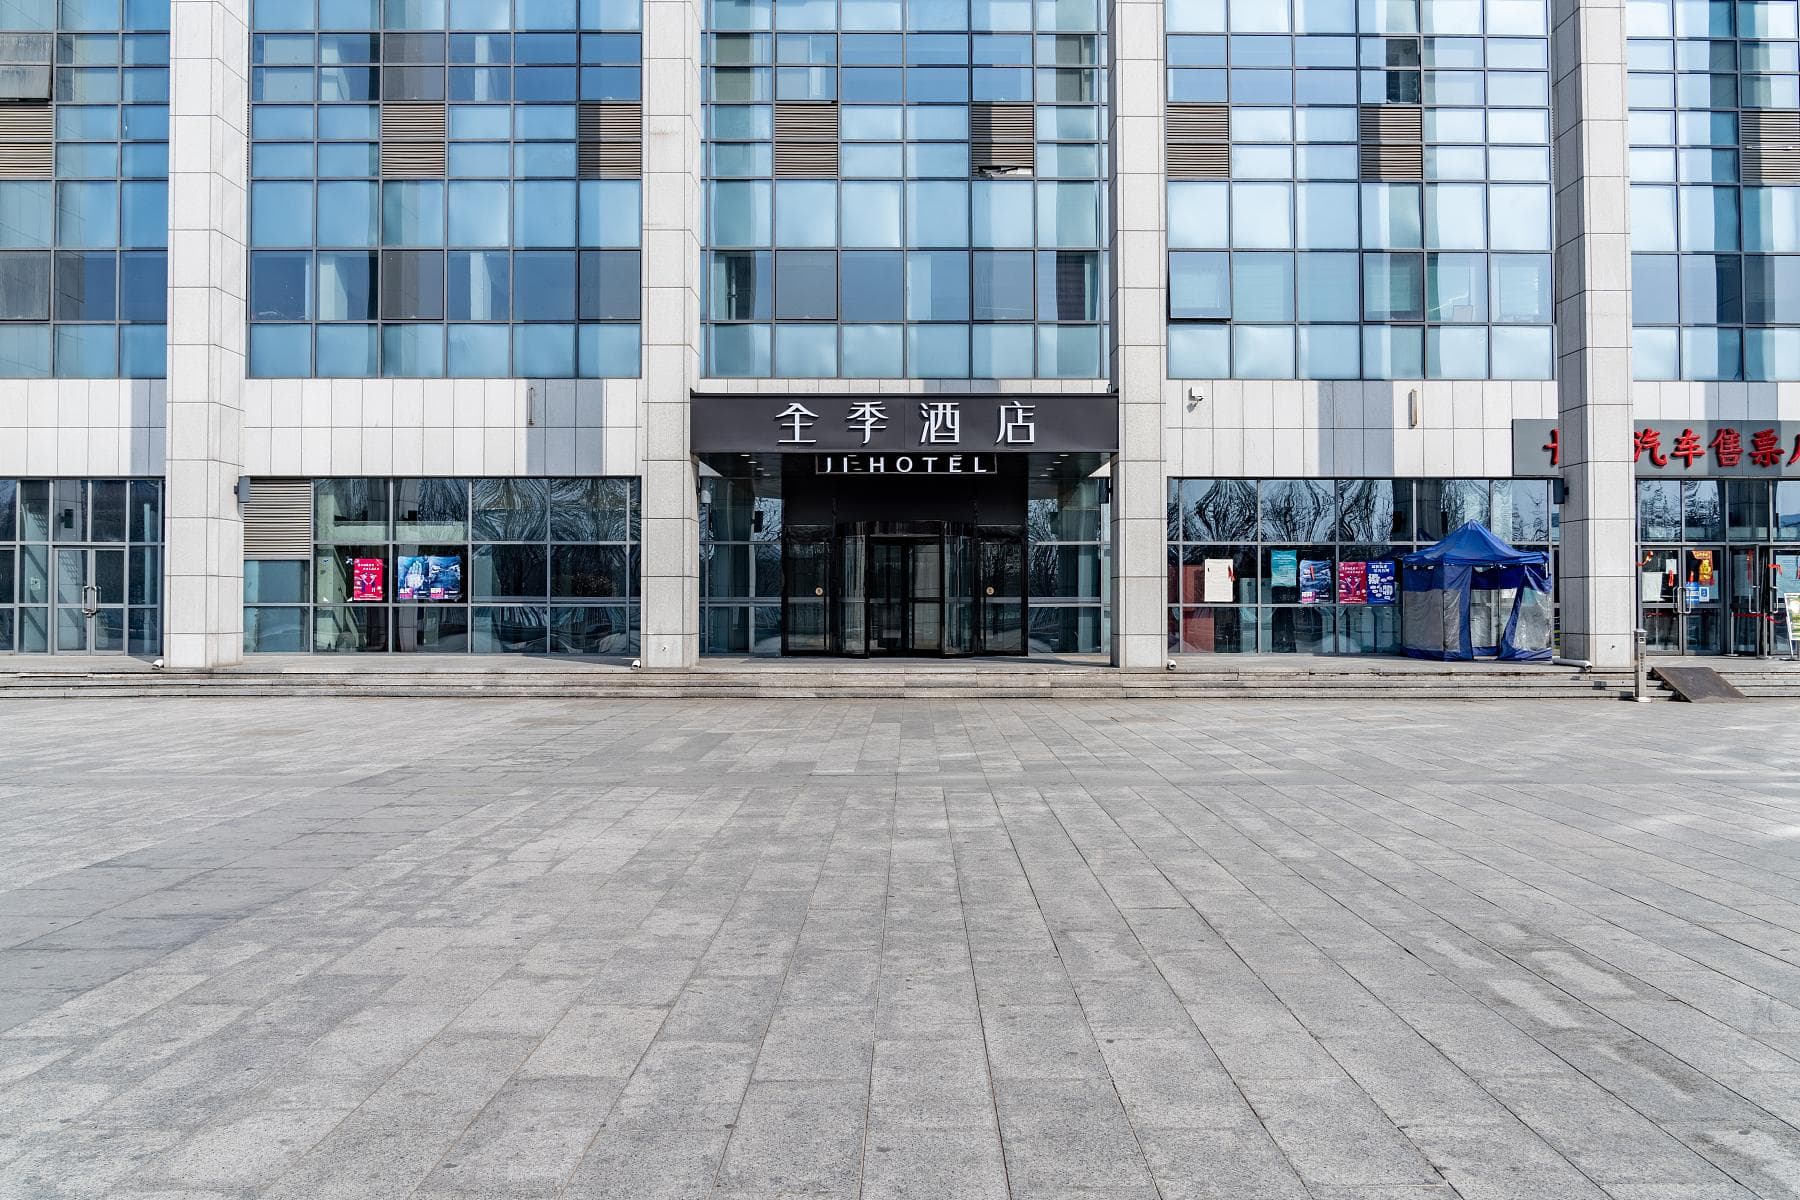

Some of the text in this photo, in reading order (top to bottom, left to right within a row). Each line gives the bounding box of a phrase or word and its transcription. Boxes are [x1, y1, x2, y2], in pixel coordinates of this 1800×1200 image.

[775, 400, 1036, 444] 全季酒店
[826, 456, 987, 473] JI HOTEL
[1542, 427, 1800, 467] 汽车售票
